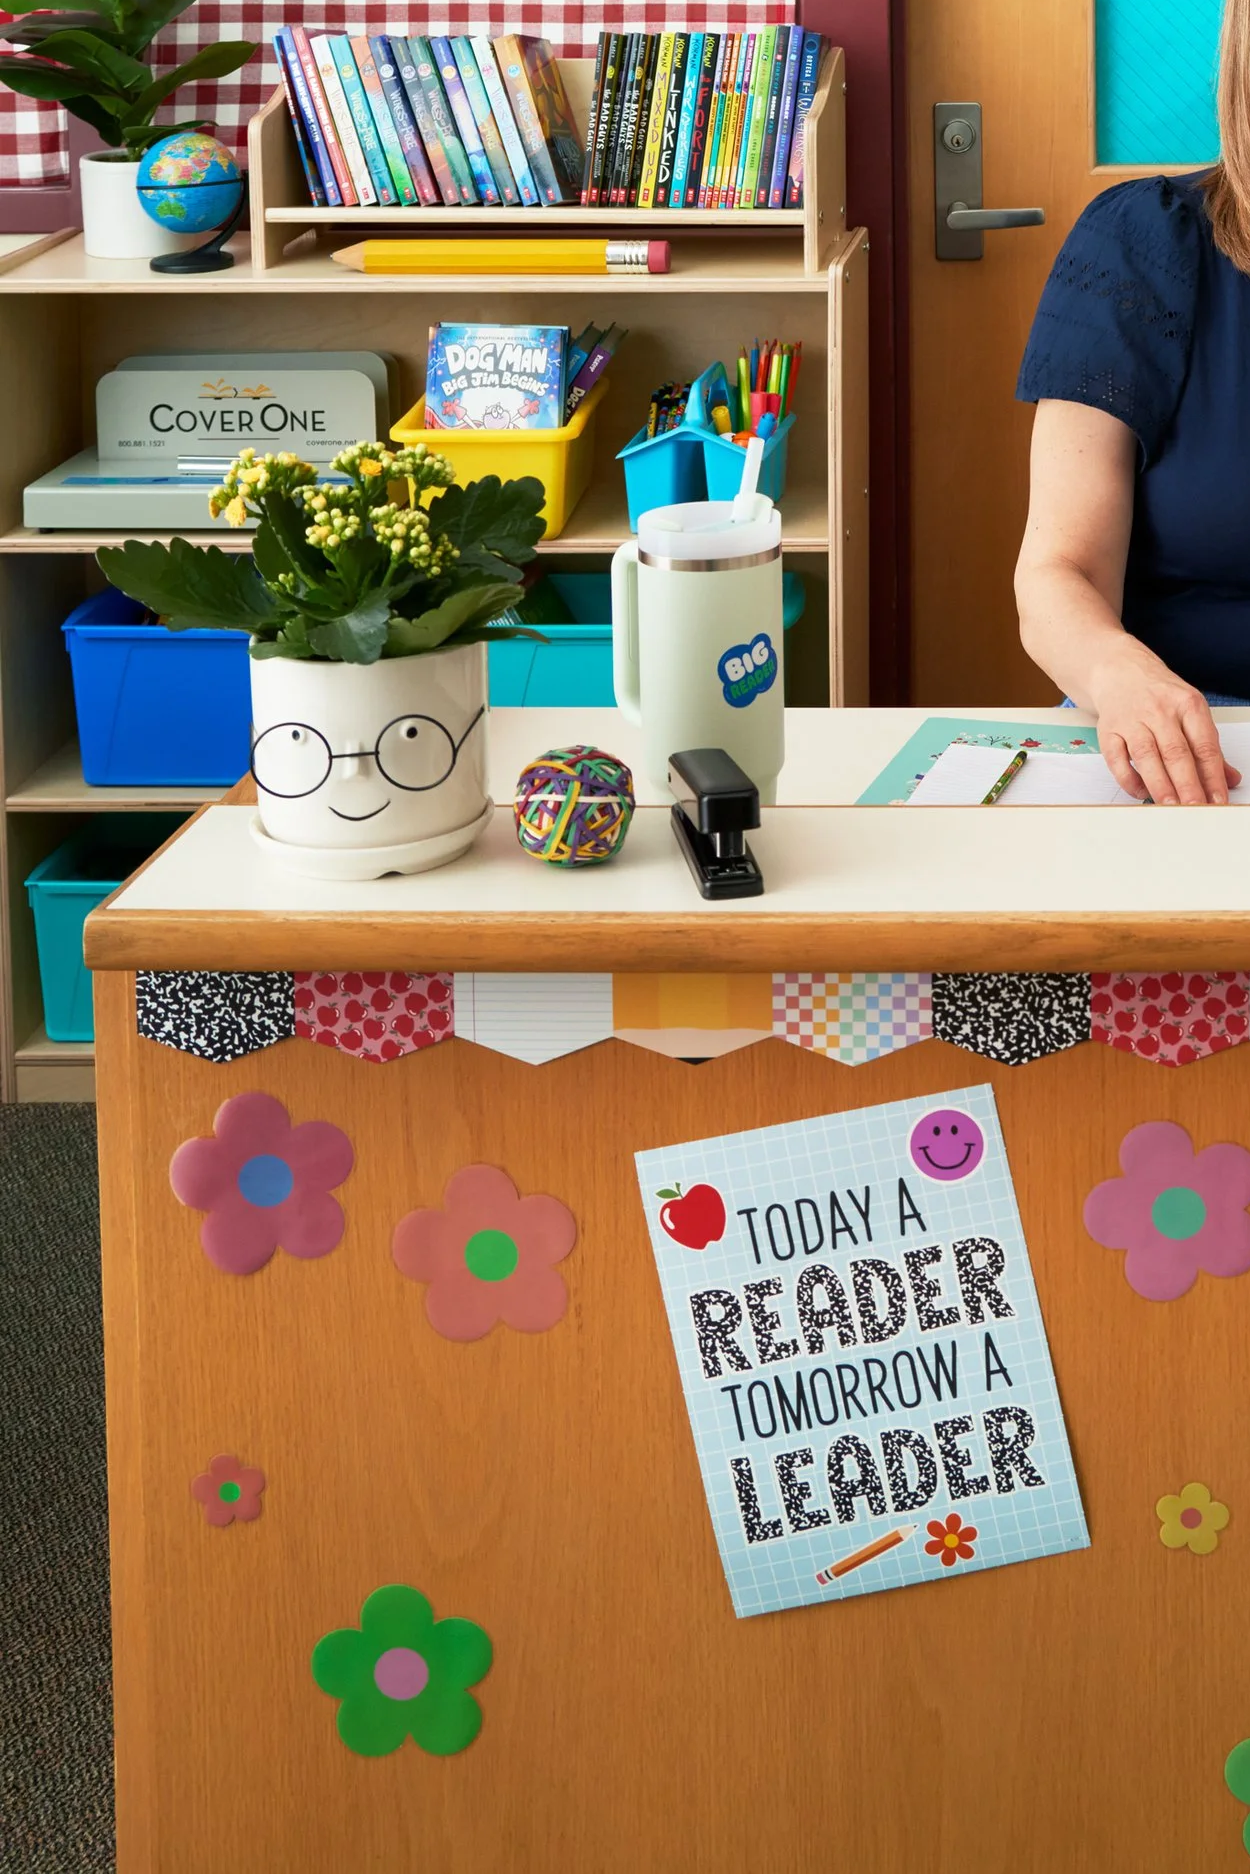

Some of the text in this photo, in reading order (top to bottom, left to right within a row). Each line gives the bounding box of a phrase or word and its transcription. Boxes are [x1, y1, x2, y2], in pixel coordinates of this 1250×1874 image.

[661, 36, 672, 68] KORMAN
[675, 37, 686, 69] KORMAN
[691, 37, 701, 70] KORMAN
[703, 36, 716, 68] KORMAN
[804, 54, 814, 78] ORTEGA
[350, 89, 369, 125] WINGS
[390, 88, 408, 123] WINGS
[402, 125, 418, 150] FIRE
[426, 88, 446, 123] WINGS
[589, 111, 597, 130] BAD
[600, 102, 611, 124] BAD
[621, 102, 631, 121] BAD
[628, 102, 639, 124] BAD
[640, 110, 649, 128] BAD
[769, 95, 777, 120] ROBLOX
[783, 95, 791, 120] ROBLOX
[308, 123, 320, 143] CLUB
[323, 124, 335, 144] CLUB
[586, 129, 595, 152] GUYS
[596, 123, 608, 150] GUYS
[618, 119, 629, 144] GUYS
[625, 123, 636, 151] GUYS
[636, 126, 646, 151] GUYS
[644, 71, 667, 184] MIXED UP
[658, 73, 681, 184] LINKED
[673, 75, 697, 181] WAR STORIES
[691, 88, 710, 172] FORT
[444, 343, 496, 375] DOG
[498, 342, 549, 374] MAN
[566, 386, 586, 408] DOG
[117, 438, 357, 448] 800.881.1521 coverone.net
[724, 640, 769, 682] BIG
[730, 658, 775, 700] READER
[736, 1176, 928, 1265] TODAY A
[687, 1236, 1016, 1381] READER
[720, 1331, 1014, 1442] TOMORROW A
[729, 1405, 1047, 1545] LEADER
